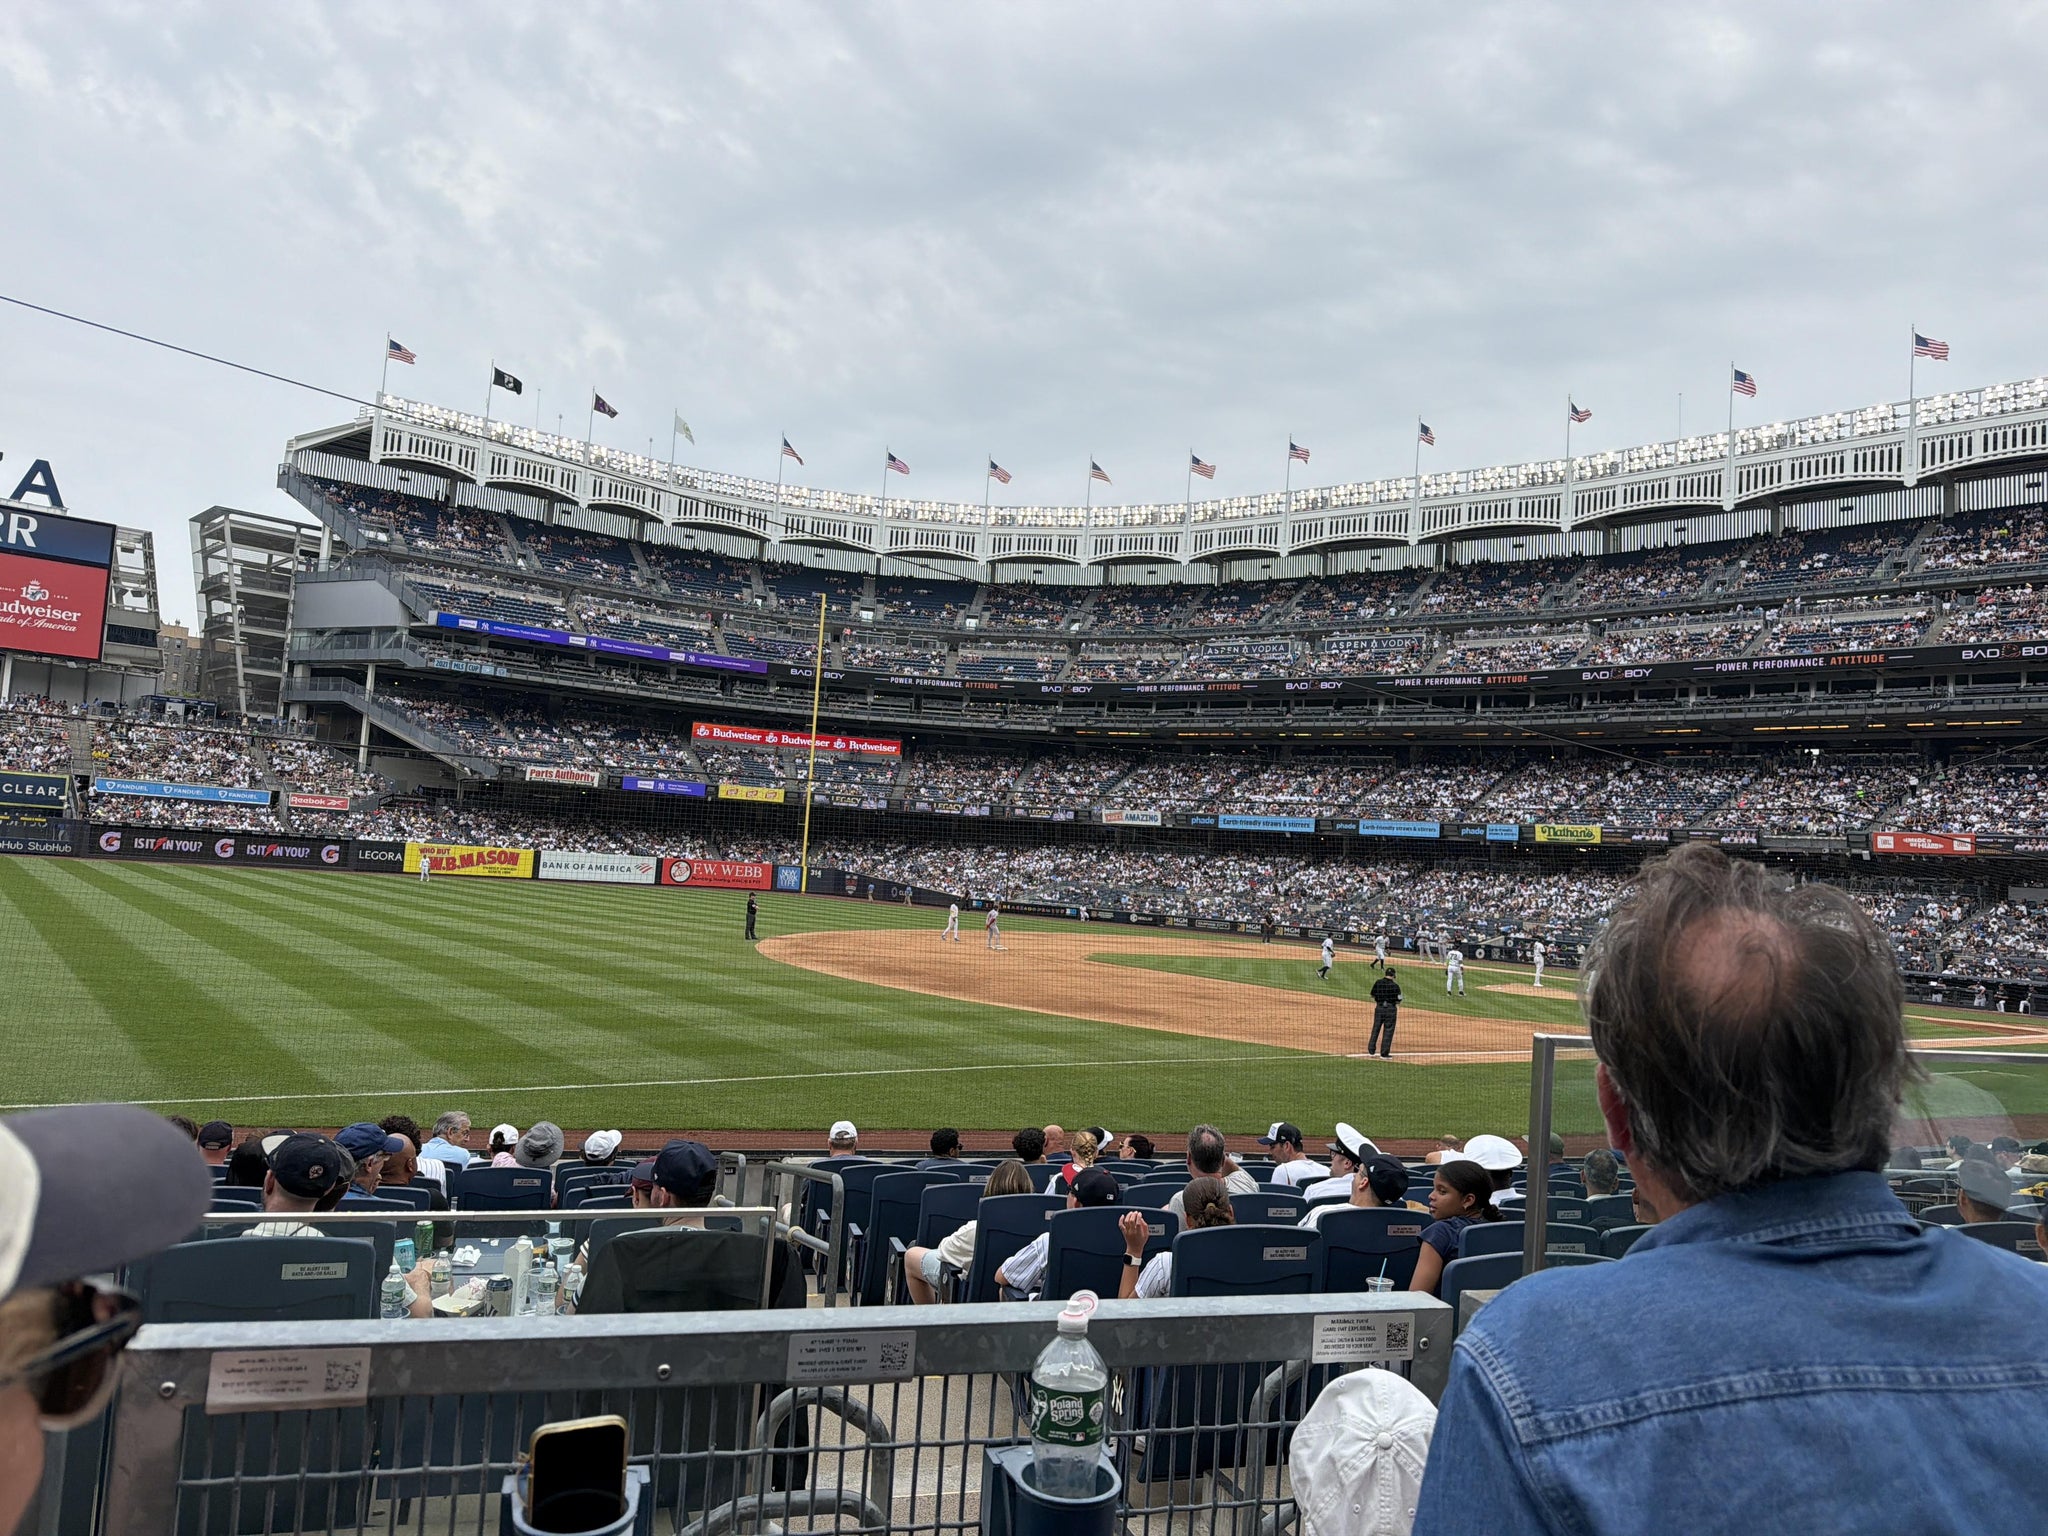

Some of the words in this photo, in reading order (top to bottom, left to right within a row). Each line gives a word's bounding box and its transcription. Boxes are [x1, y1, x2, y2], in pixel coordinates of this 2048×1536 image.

[0, 452, 65, 508] A
[0, 512, 38, 548] R
[30, 618, 77, 632] America
[1208, 646, 1239, 655] ASPEN
[1252, 644, 1285, 653] VODKA
[1331, 640, 1367, 649] ASPEN
[1962, 649, 2000, 660] BAD
[1716, 662, 1750, 672] POWER.
[1753, 657, 1827, 670] PERFORMANCE.
[1830, 654, 1885, 665] ATTITUDE
[790, 668, 812, 676] BAD
[823, 672, 845, 680] BOY
[1582, 671, 1609, 680] BAD
[1624, 668, 1653, 678] BOY
[915, 679, 963, 688] PERFORMANCE.
[1395, 678, 1423, 686] POWER.
[1424, 677, 1483, 686] PERFORMANCE.
[1486, 675, 1528, 684] ATTITUDE
[1160, 684, 1205, 692] PERFORMANCE.
[713, 728, 761, 741] Budweiser
[781, 735, 830, 747] Budweser
[849, 741, 897, 752] Budweiser
[530, 769, 553, 778] Parts
[555, 770, 595, 782] Authority
[2, 784, 57, 796] CLEAR
[291, 796, 325, 806] Reebok
[1125, 813, 1158, 822] AMAZING
[1541, 825, 1593, 838] Nathan's
[28, 841, 72, 852] StubHub
[100, 832, 121, 852] G
[176, 840, 203, 852] YOU?
[215, 838, 234, 858] G
[284, 847, 310, 858] YOU?
[321, 845, 339, 864] G
[359, 850, 402, 862] LEGORA
[588, 864, 632, 873] AMERICA
[693, 863, 717, 875] F.W.
[721, 864, 762, 878] WEBB
[810, 870, 822, 878] 314
[1050, 1397, 1082, 1410] Poland
[1051, 1408, 1084, 1422] Spring
